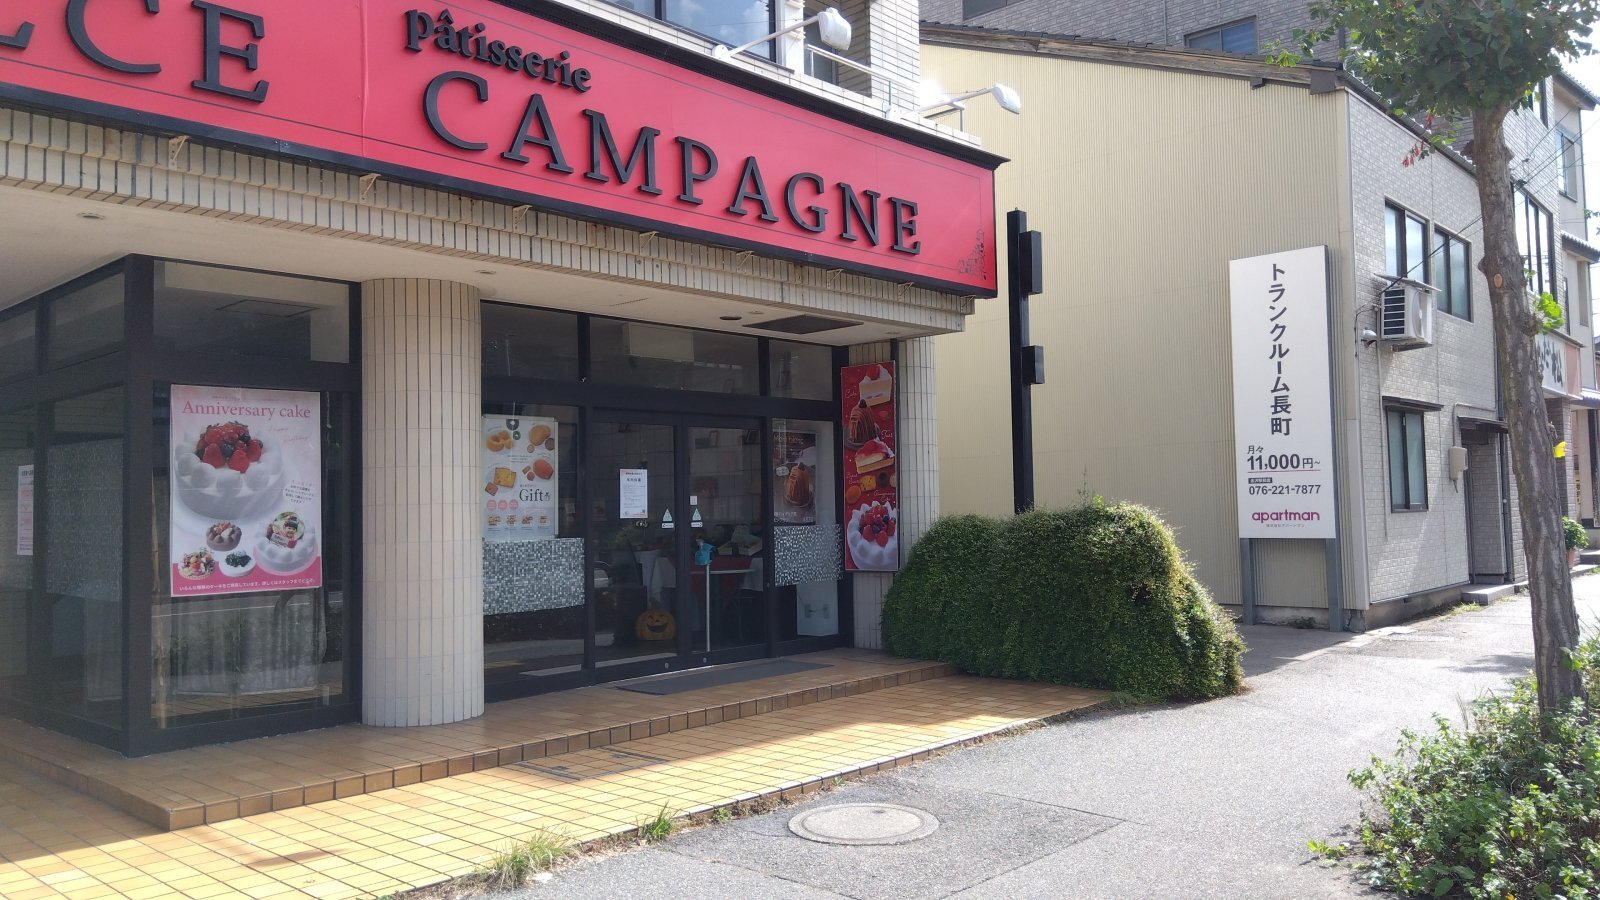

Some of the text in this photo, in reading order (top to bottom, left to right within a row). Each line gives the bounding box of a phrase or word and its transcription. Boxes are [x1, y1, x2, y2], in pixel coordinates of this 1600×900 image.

[0, 0, 269, 103] CE
[405, 9, 591, 93] pâtisserie
[423, 70, 920, 255] CAMPAGNE
[1268, 263, 1292, 436] トランクルーム長町
[182, 400, 311, 421] Anniversary cake
[1247, 445, 1264, 454] 月々
[519, 488, 543, 502] Gift
[1248, 484, 1321, 496] 076-221-7877
[1252, 509, 1321, 523] apartman
